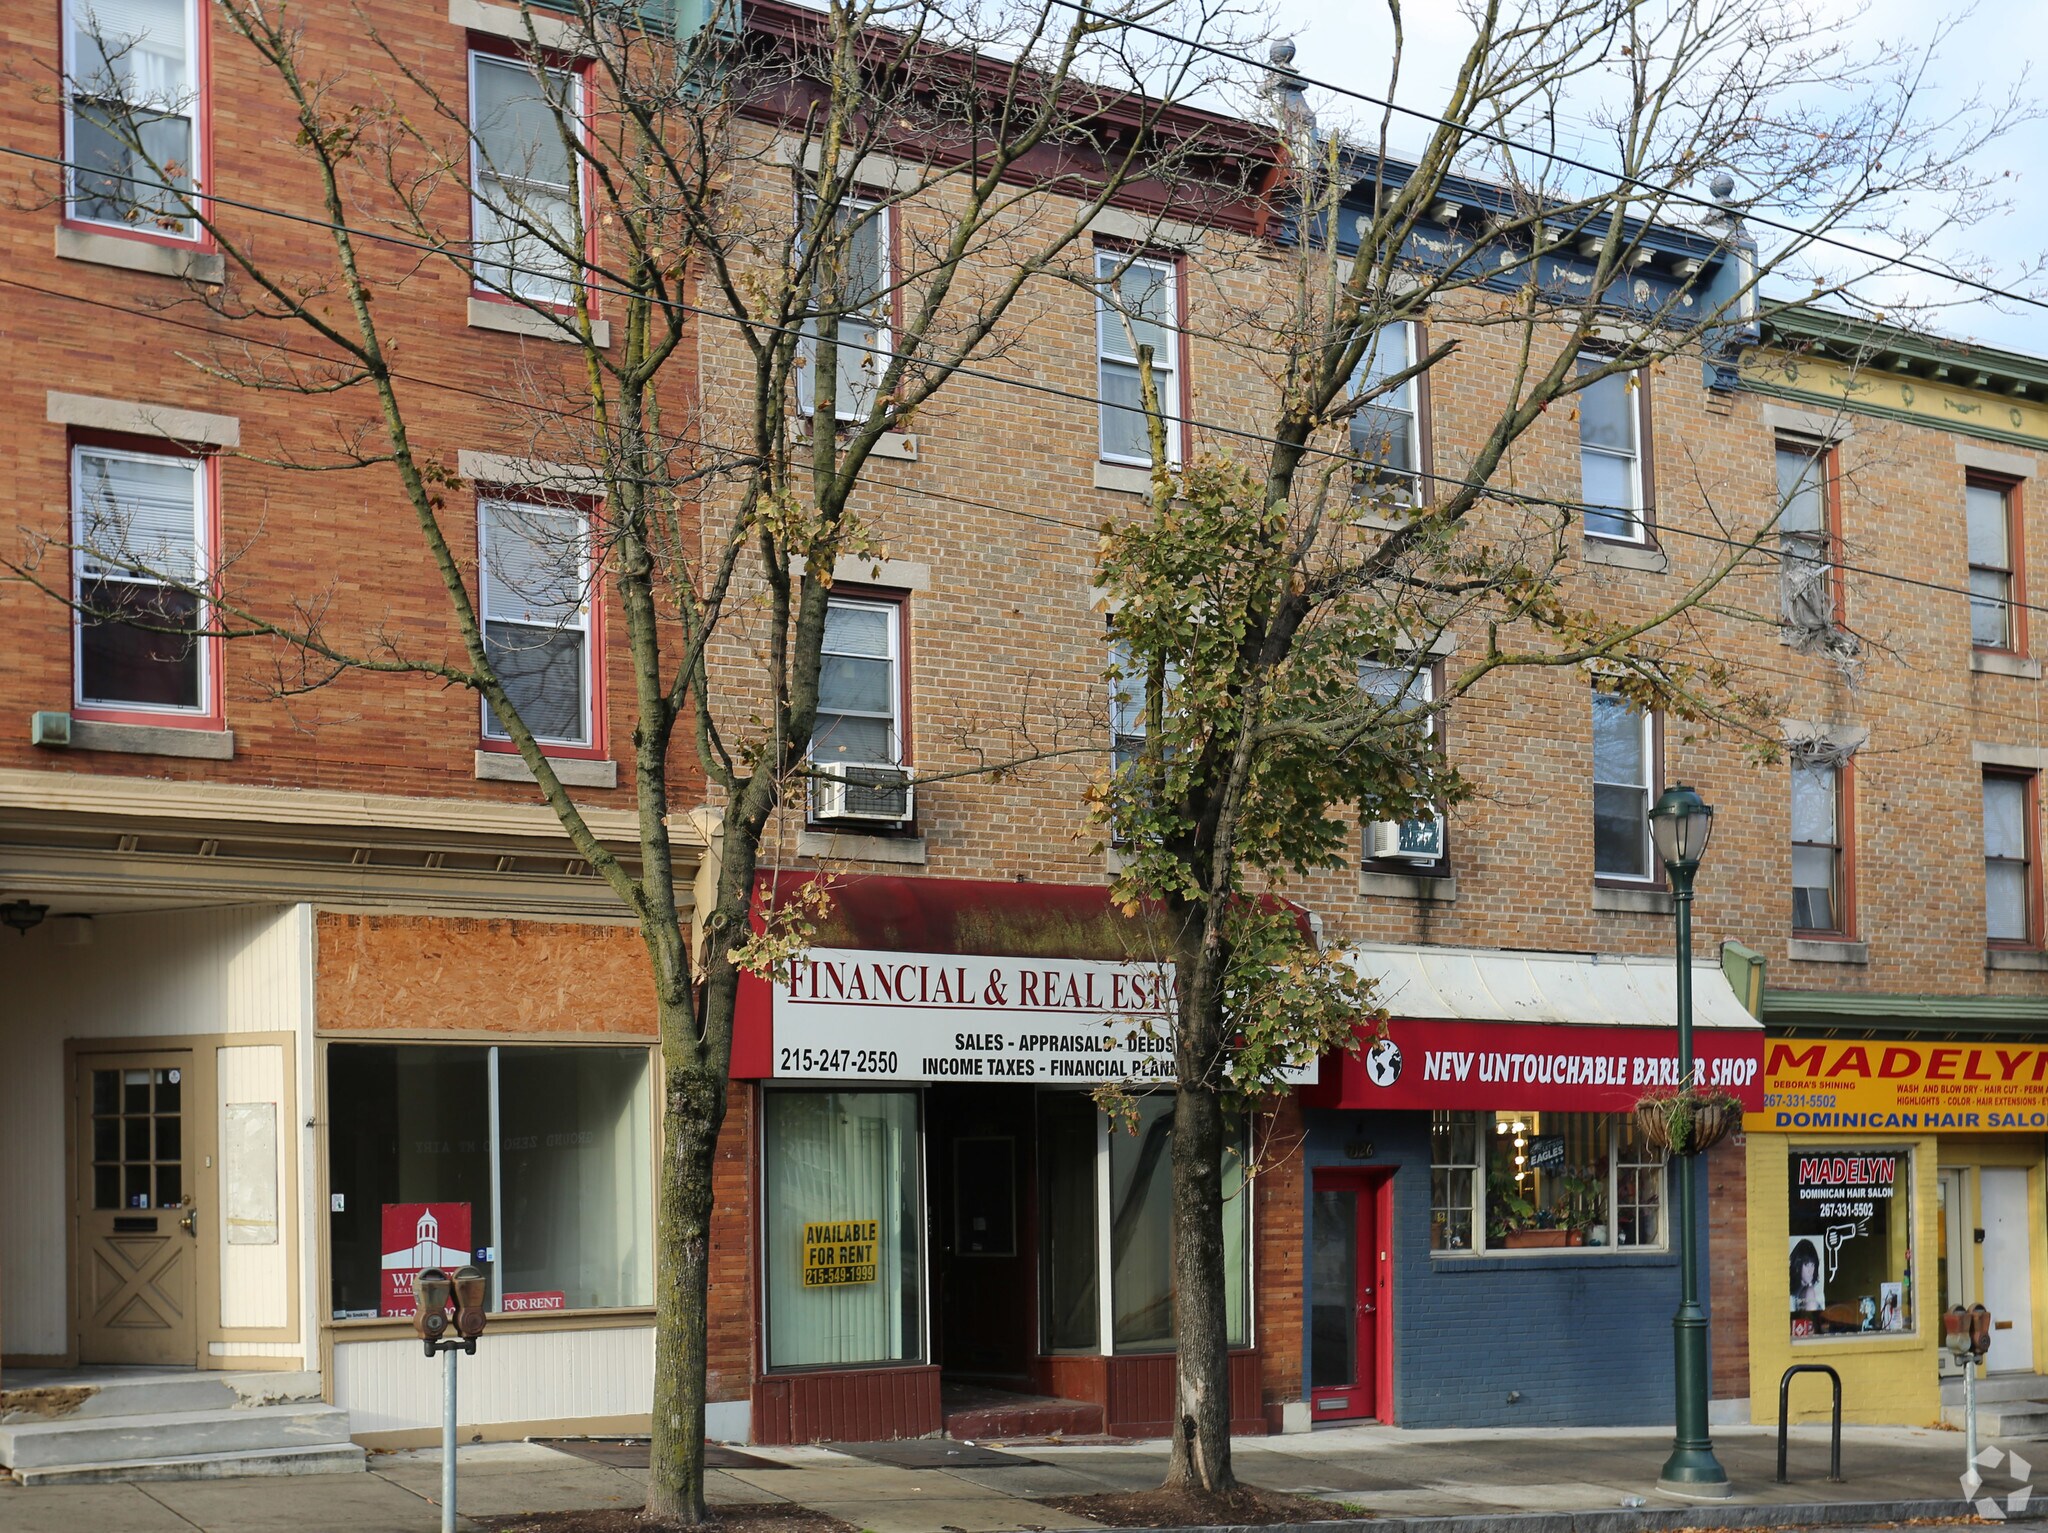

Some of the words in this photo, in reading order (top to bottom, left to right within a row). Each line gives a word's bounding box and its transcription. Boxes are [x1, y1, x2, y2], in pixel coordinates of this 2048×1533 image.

[788, 960, 976, 1003] FINANCIAL
[984, 969, 1008, 1005] &
[1019, 970, 1104, 1008] REAL
[955, 1033, 1004, 1051] SALES
[1019, 1035, 1113, 1052] APPRAISALS
[1128, 1036, 1174, 1053] DEEDS
[781, 1048, 898, 1074] 215-247-2550
[922, 1058, 983, 1075] INCOME
[987, 1059, 1035, 1076] TAXES
[1051, 1060, 1128, 1077] FINANCIAL
[1424, 1051, 1475, 1082] NEW
[1479, 1053, 1628, 1085] UNTOUCHABLE
[1711, 1058, 1758, 1086] SHOP
[1774, 1081, 1817, 1089] DEBORA'S
[1820, 1081, 1856, 1090] SHINING
[1897, 1084, 1918, 1093] WASH
[1923, 1084, 1938, 1093] AND
[1941, 1085, 1961, 1094] BLOW
[1964, 1085, 1978, 1094] DRY
[1984, 1085, 2001, 1094] HAIR
[2004, 1085, 2018, 1094] CUT
[2024, 1085, 2043, 1094] PERM
[1764, 1094, 1837, 1108] 267-331-5502
[1897, 1096, 1940, 1105] HIGHLIGHTS
[1948, 1097, 1971, 1106] COLOR
[1977, 1097, 1992, 1106] HAIR
[1995, 1097, 2036, 1106] EXTENSIONS
[1776, 1112, 1918, 1128] DOMINICAN
[1924, 1112, 1980, 1128] HAIR
[1987, 1112, 2048, 1127] SALO
[1530, 1145, 1564, 1166] EAGLES
[1799, 1158, 1895, 1185] MADELYN
[1800, 1188, 1845, 1199] DOMINICAN
[1847, 1188, 1866, 1198] HAIR
[1868, 1187, 1893, 1198] SALON
[807, 1223, 876, 1244] AVAILABLE
[810, 1246, 835, 1266] FOR
[840, 1245, 872, 1264] RENT
[504, 1298, 528, 1311] FOR
[529, 1296, 562, 1309] RENT
